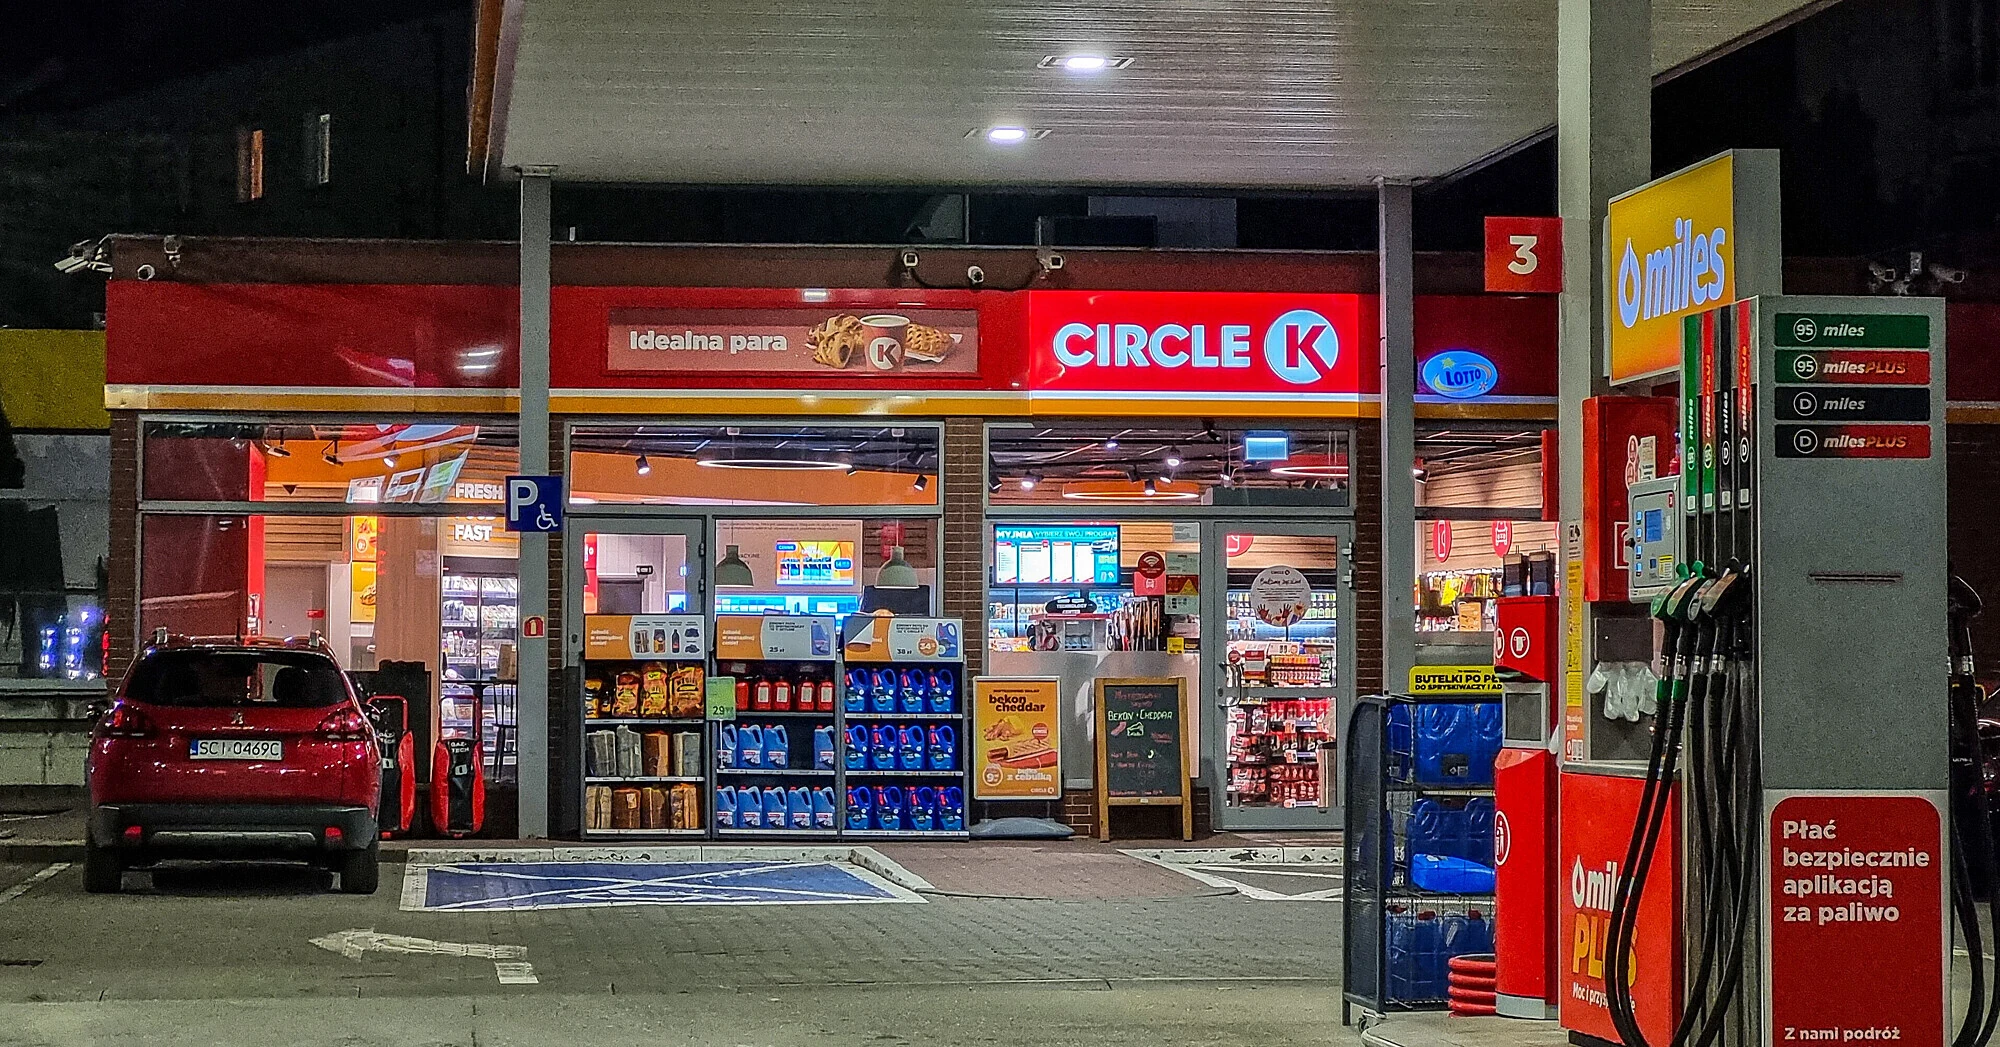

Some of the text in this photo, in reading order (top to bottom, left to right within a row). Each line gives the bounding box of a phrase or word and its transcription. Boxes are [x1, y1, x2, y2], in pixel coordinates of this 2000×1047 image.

[1508, 236, 1538, 275] 3
[1643, 218, 1726, 320] miles
[1796, 324, 1865, 337] 95 miles
[629, 330, 788, 354] Idealna para
[1052, 322, 1251, 368] CIRCLE
[1797, 361, 1907, 374] 95 milesPLUS
[1445, 368, 1482, 387] LOTTO
[1799, 398, 1866, 411] D miles
[1799, 435, 1907, 448] D milesPLUS
[455, 483, 503, 500] FRESH
[510, 480, 539, 521] P
[455, 524, 493, 542] FAST
[996, 530, 1034, 539] MYJNIA
[1415, 674, 1462, 684] BUTELKI
[1465, 674, 1481, 684] PO
[989, 694, 1027, 704] bekon
[995, 702, 1046, 712] cheddar
[712, 706, 725, 716] 29
[1108, 710, 1134, 721] BEKON
[1140, 709, 1173, 720] CHEDDAR
[233, 742, 280, 756] 0469C
[1783, 819, 1837, 840] Płać
[1783, 847, 1930, 871] bezpiecznie
[1783, 874, 1893, 898] aplikacją
[1783, 902, 1900, 925] za paliwo
[1573, 981, 1586, 1001] Moc
[1784, 1026, 1901, 1043] Z nami podróż
